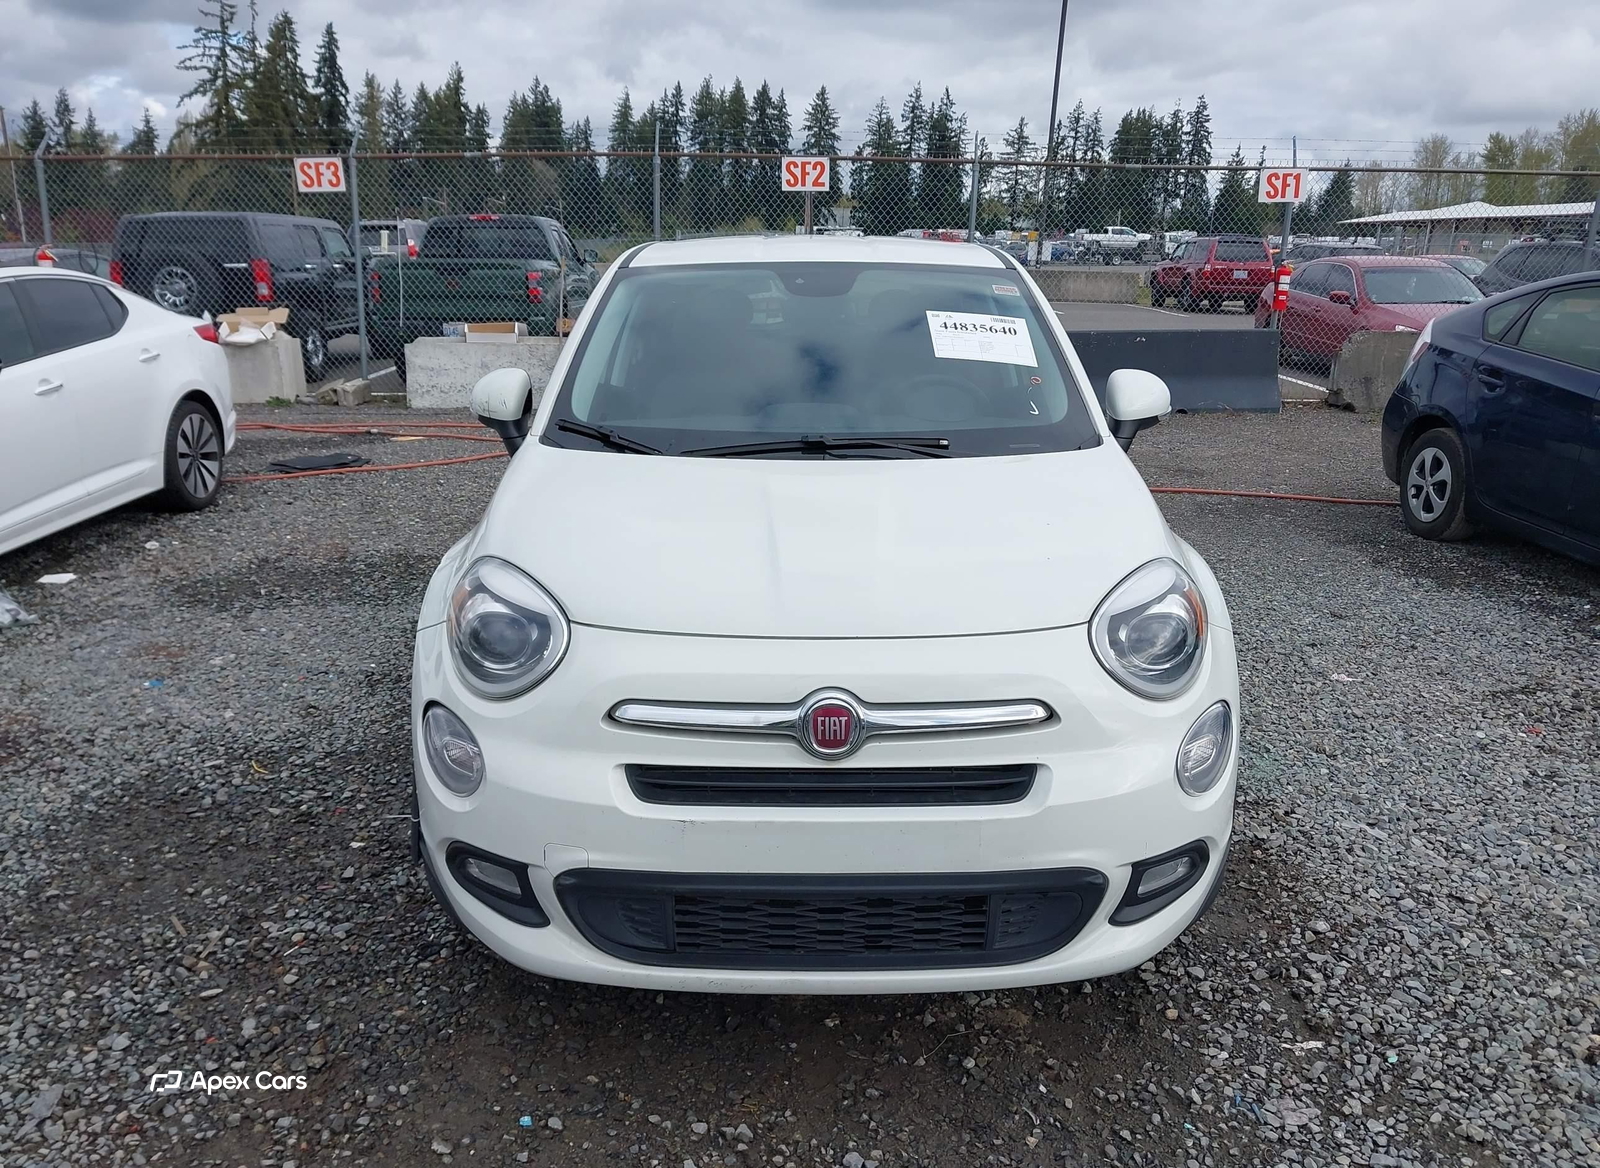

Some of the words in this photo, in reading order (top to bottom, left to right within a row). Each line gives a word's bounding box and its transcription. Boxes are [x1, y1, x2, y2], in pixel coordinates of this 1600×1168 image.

[299, 161, 341, 188] SF3
[785, 161, 826, 187] SF2
[1265, 172, 1301, 199] SF1
[939, 321, 1017, 336] 44835640
[817, 716, 848, 740] FIAT
